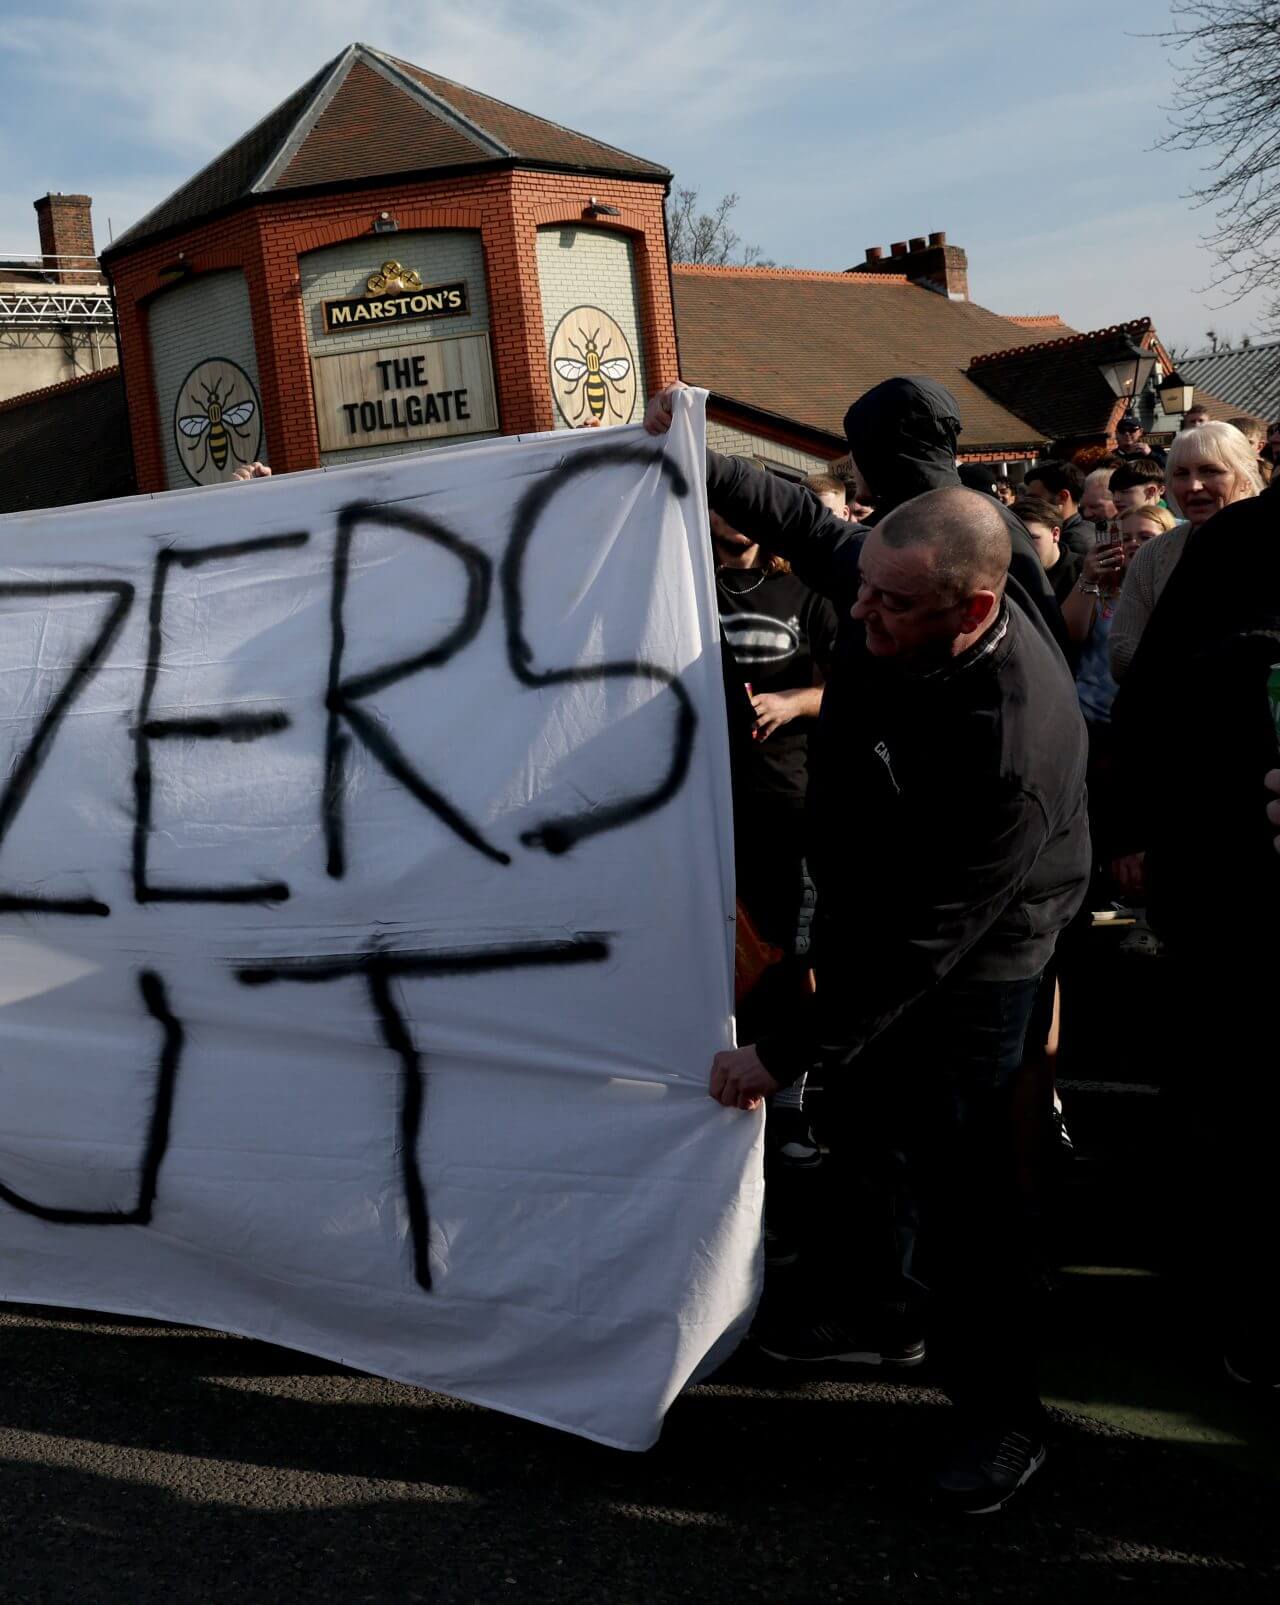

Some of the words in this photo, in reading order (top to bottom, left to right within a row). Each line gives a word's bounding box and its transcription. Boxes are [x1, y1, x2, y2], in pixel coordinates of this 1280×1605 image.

[331, 290, 462, 324] MARSTON'S
[376, 356, 428, 390] THE
[343, 389, 470, 433] TOLLGATE
